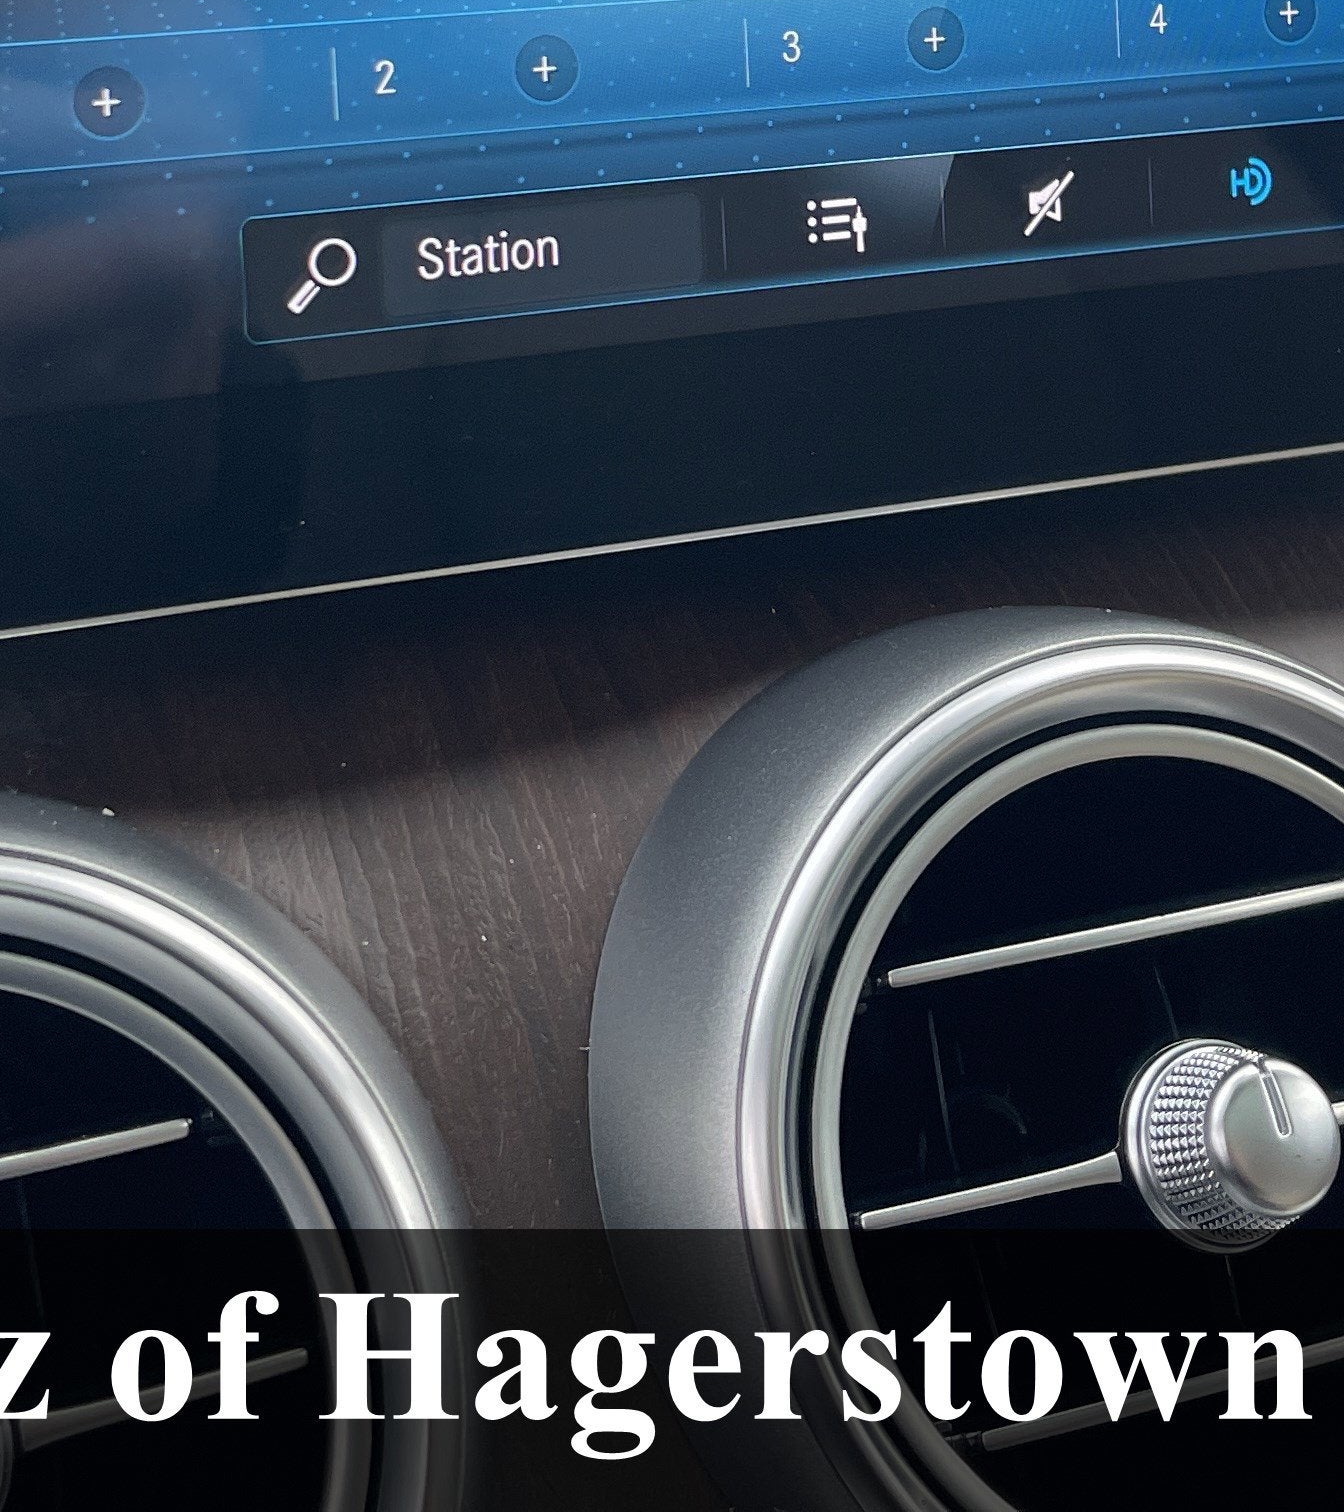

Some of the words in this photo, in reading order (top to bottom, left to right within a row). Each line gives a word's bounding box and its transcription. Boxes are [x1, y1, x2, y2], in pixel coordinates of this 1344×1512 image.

[1149, 3, 1168, 35] 4
[781, 31, 802, 63] 3
[374, 60, 398, 96] 2
[417, 227, 560, 281] Station
